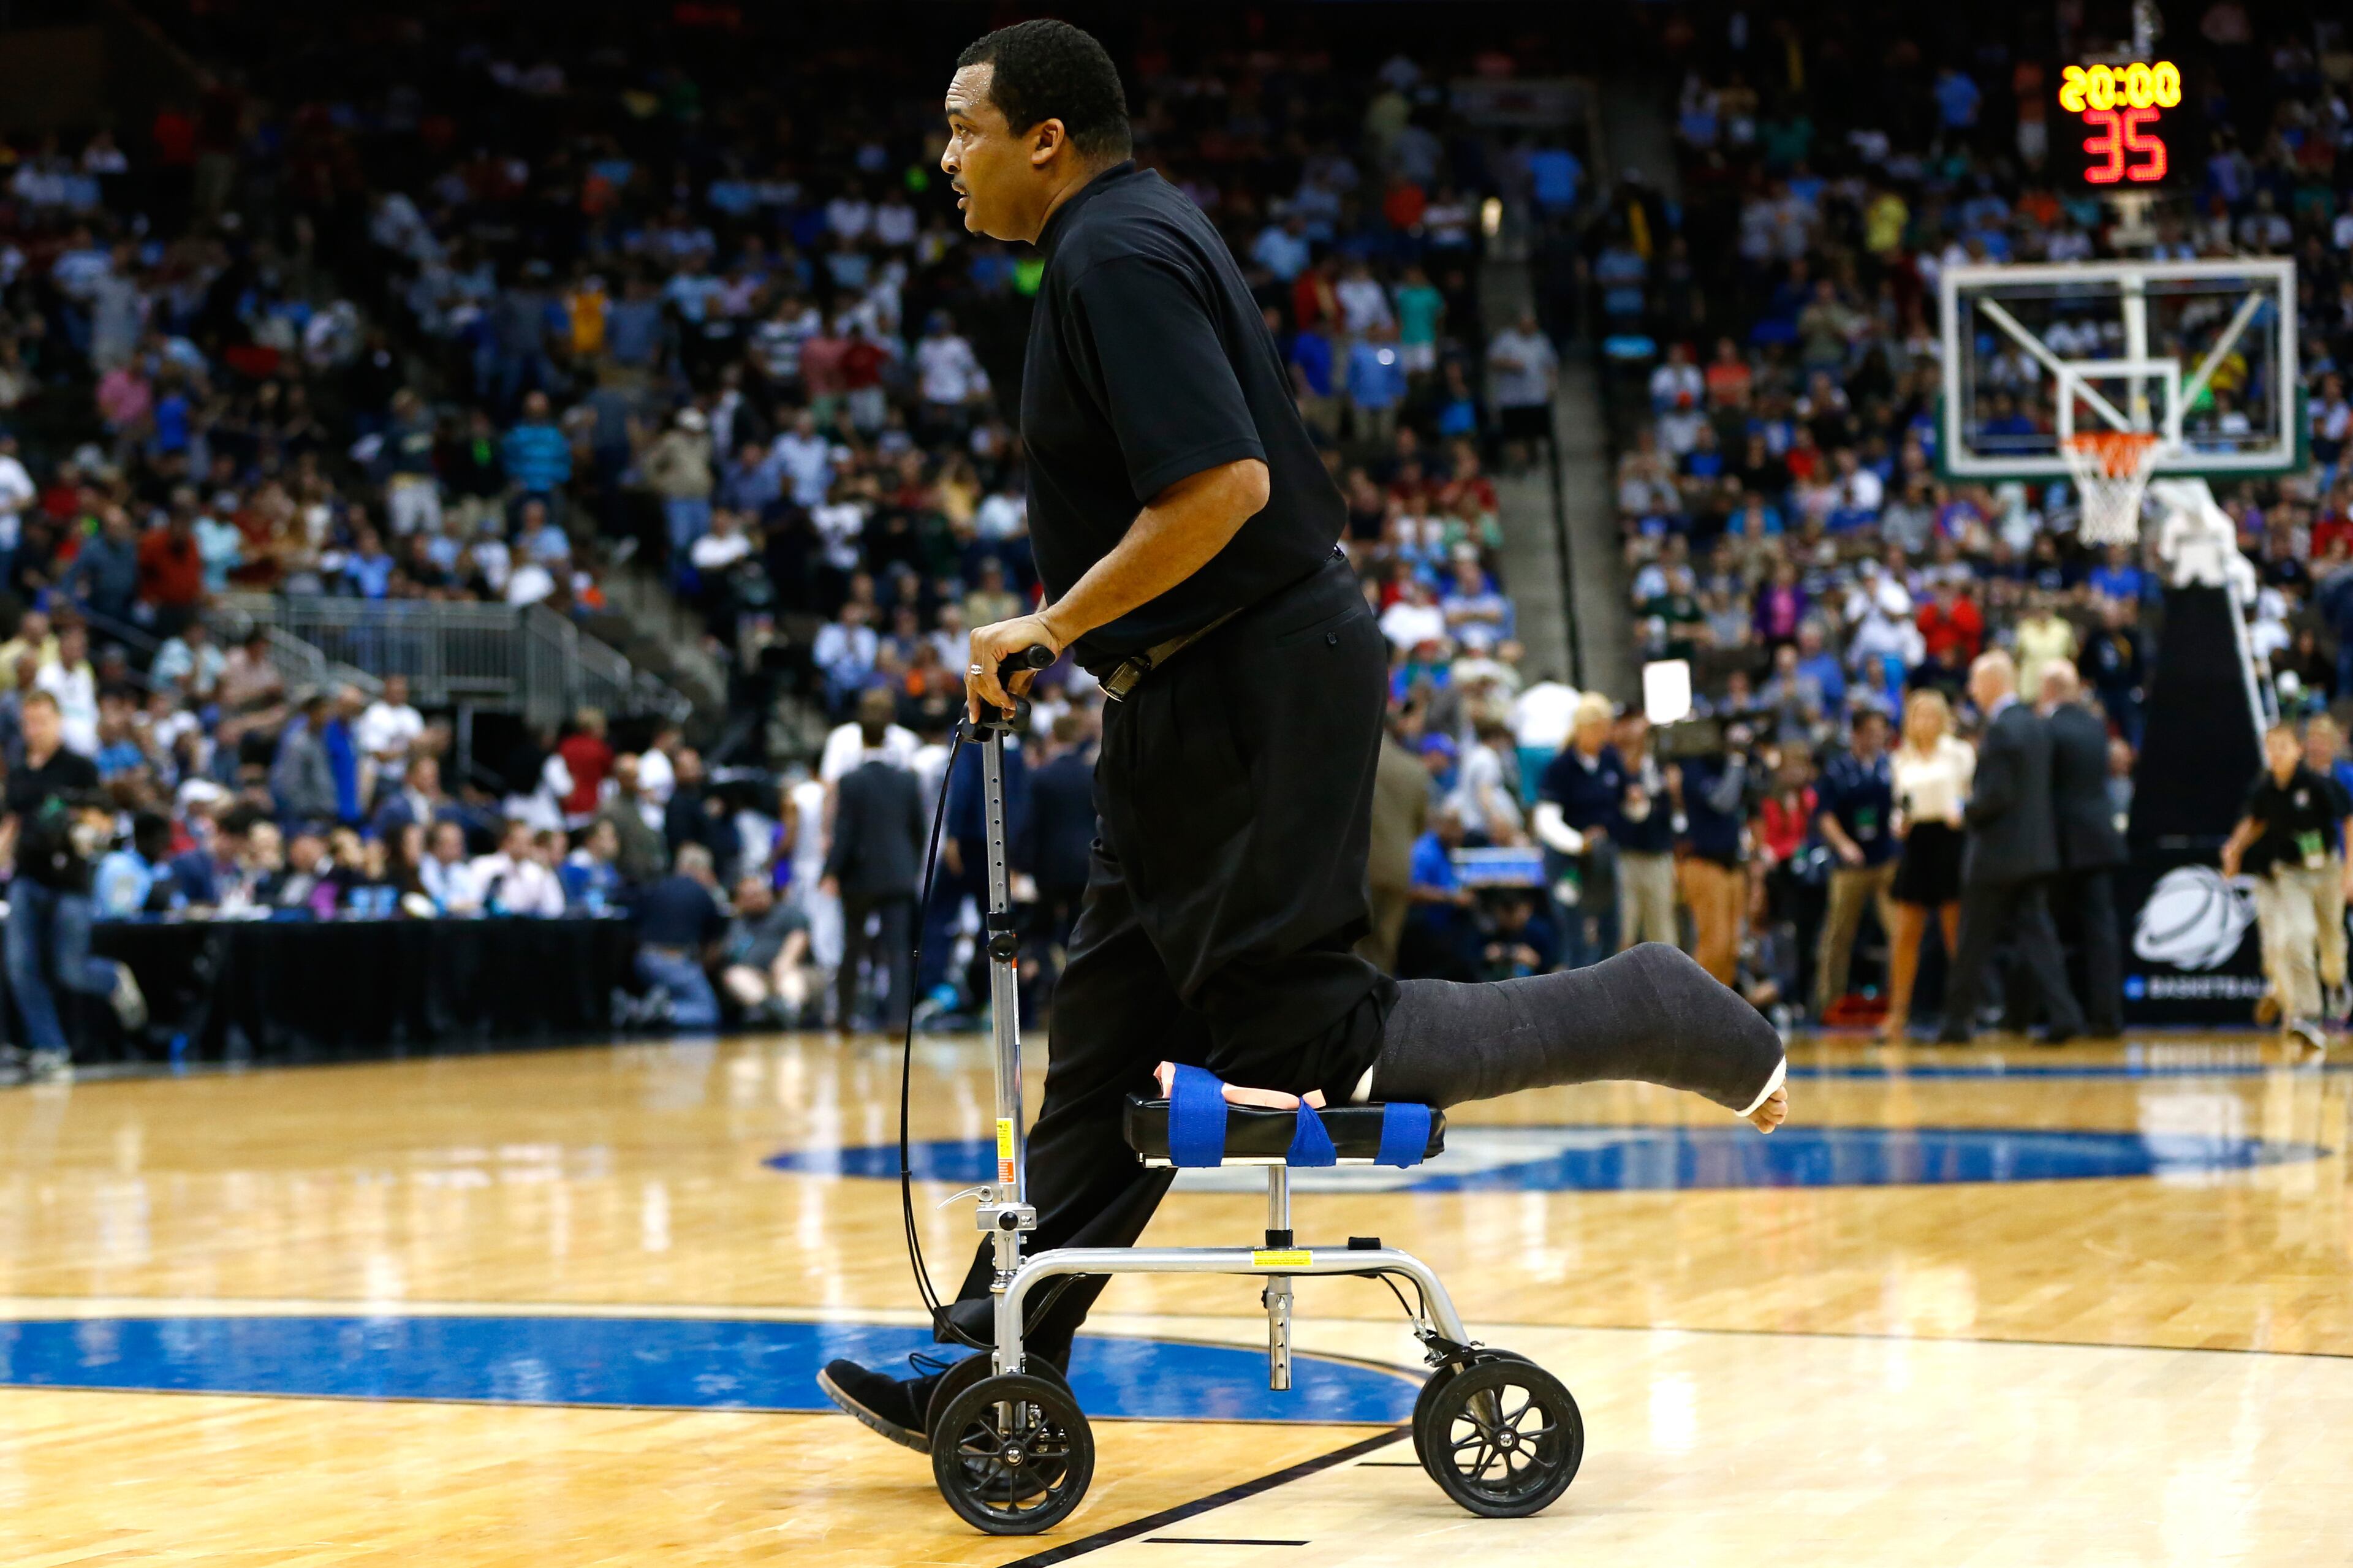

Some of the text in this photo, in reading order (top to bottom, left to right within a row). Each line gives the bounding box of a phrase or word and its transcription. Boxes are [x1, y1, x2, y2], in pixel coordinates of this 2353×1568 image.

[2059, 61, 2181, 112] 20:00
[2083, 106, 2167, 183] 35
[2149, 974, 2265, 1000] BASKETBAL
